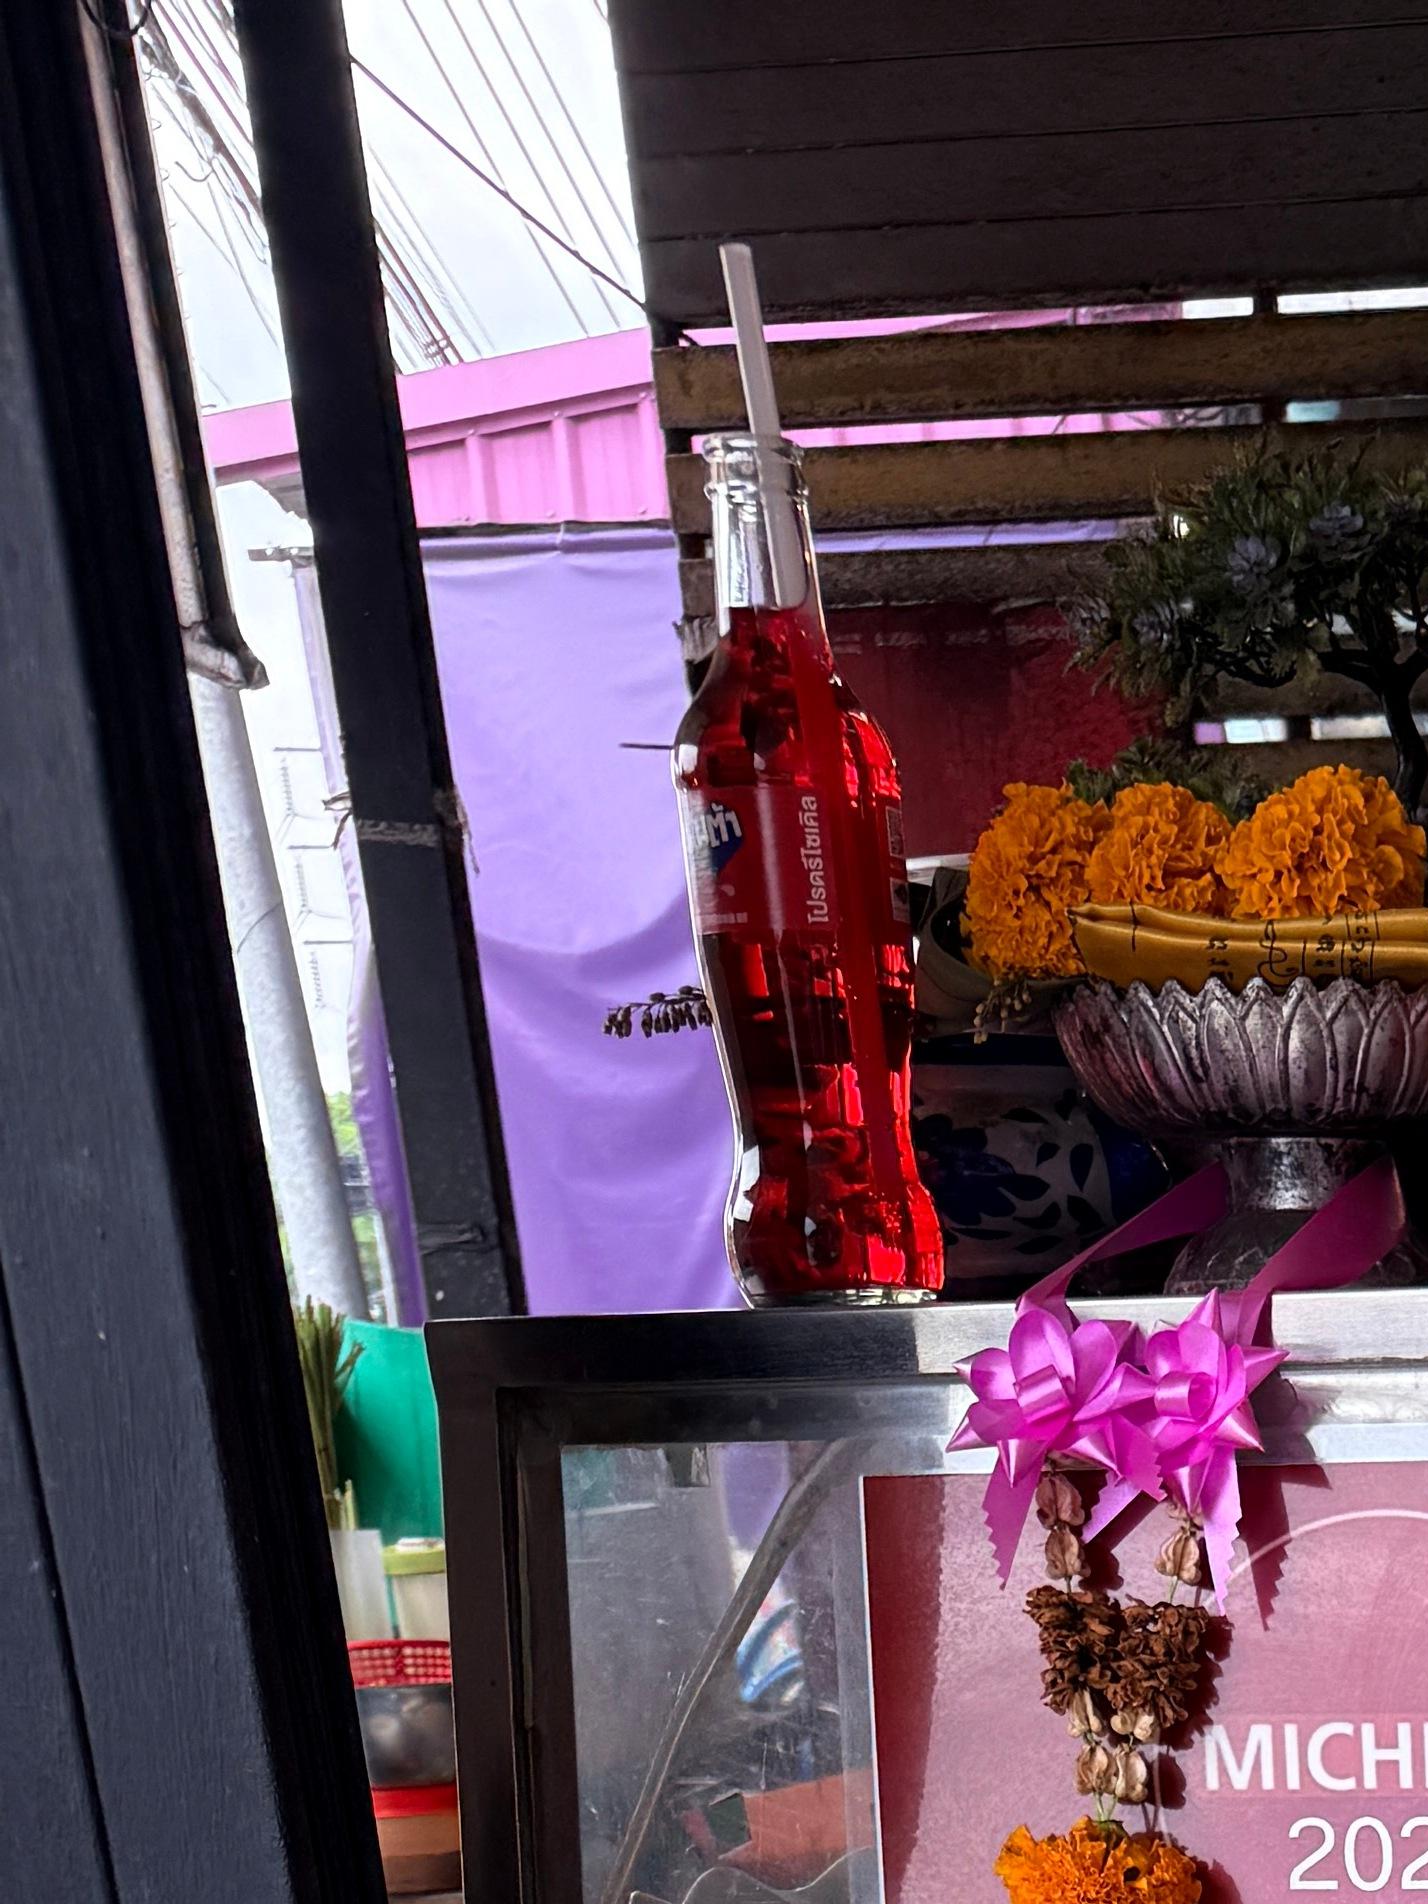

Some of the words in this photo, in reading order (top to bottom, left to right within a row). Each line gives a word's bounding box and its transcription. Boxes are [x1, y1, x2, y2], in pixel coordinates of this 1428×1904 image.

[798, 795, 829, 924] โปรดรีไซเคิล
